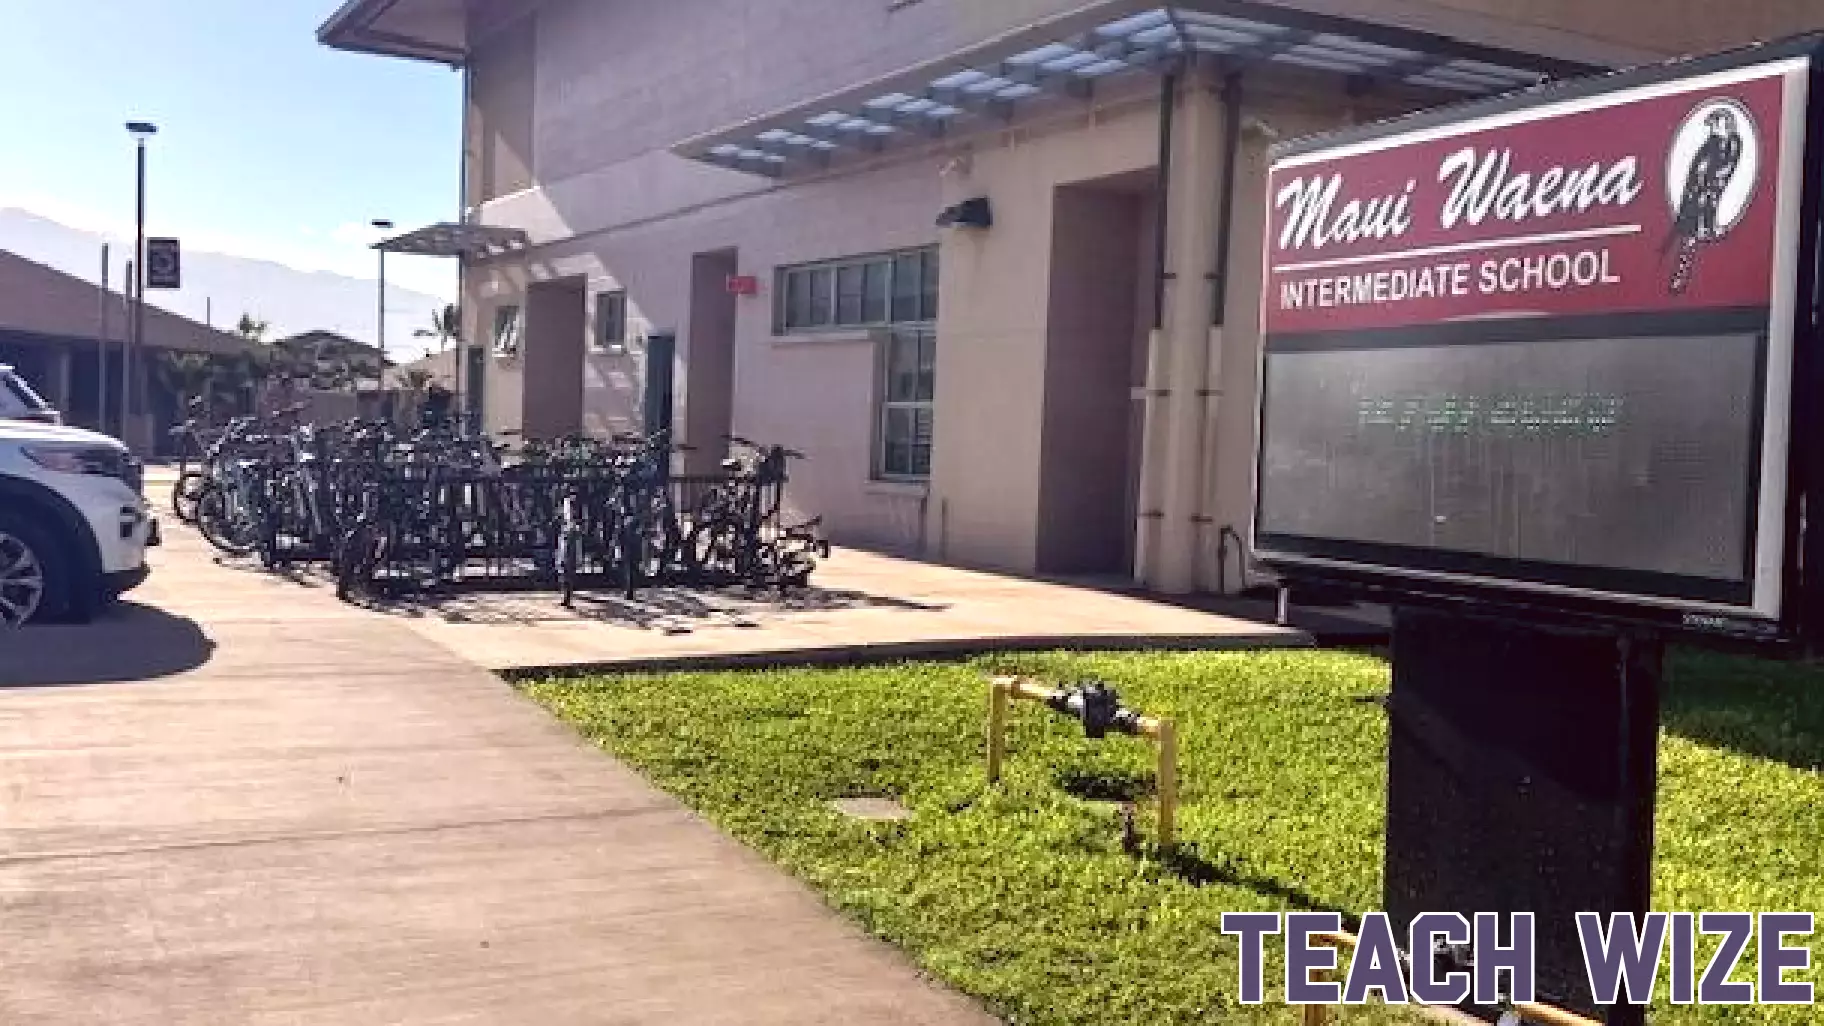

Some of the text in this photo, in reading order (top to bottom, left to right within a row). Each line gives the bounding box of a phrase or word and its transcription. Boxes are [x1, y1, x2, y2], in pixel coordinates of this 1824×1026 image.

[1275, 147, 1645, 250] Maui Waena
[1280, 249, 1620, 310] INTERMEDIATE SCHOOL
